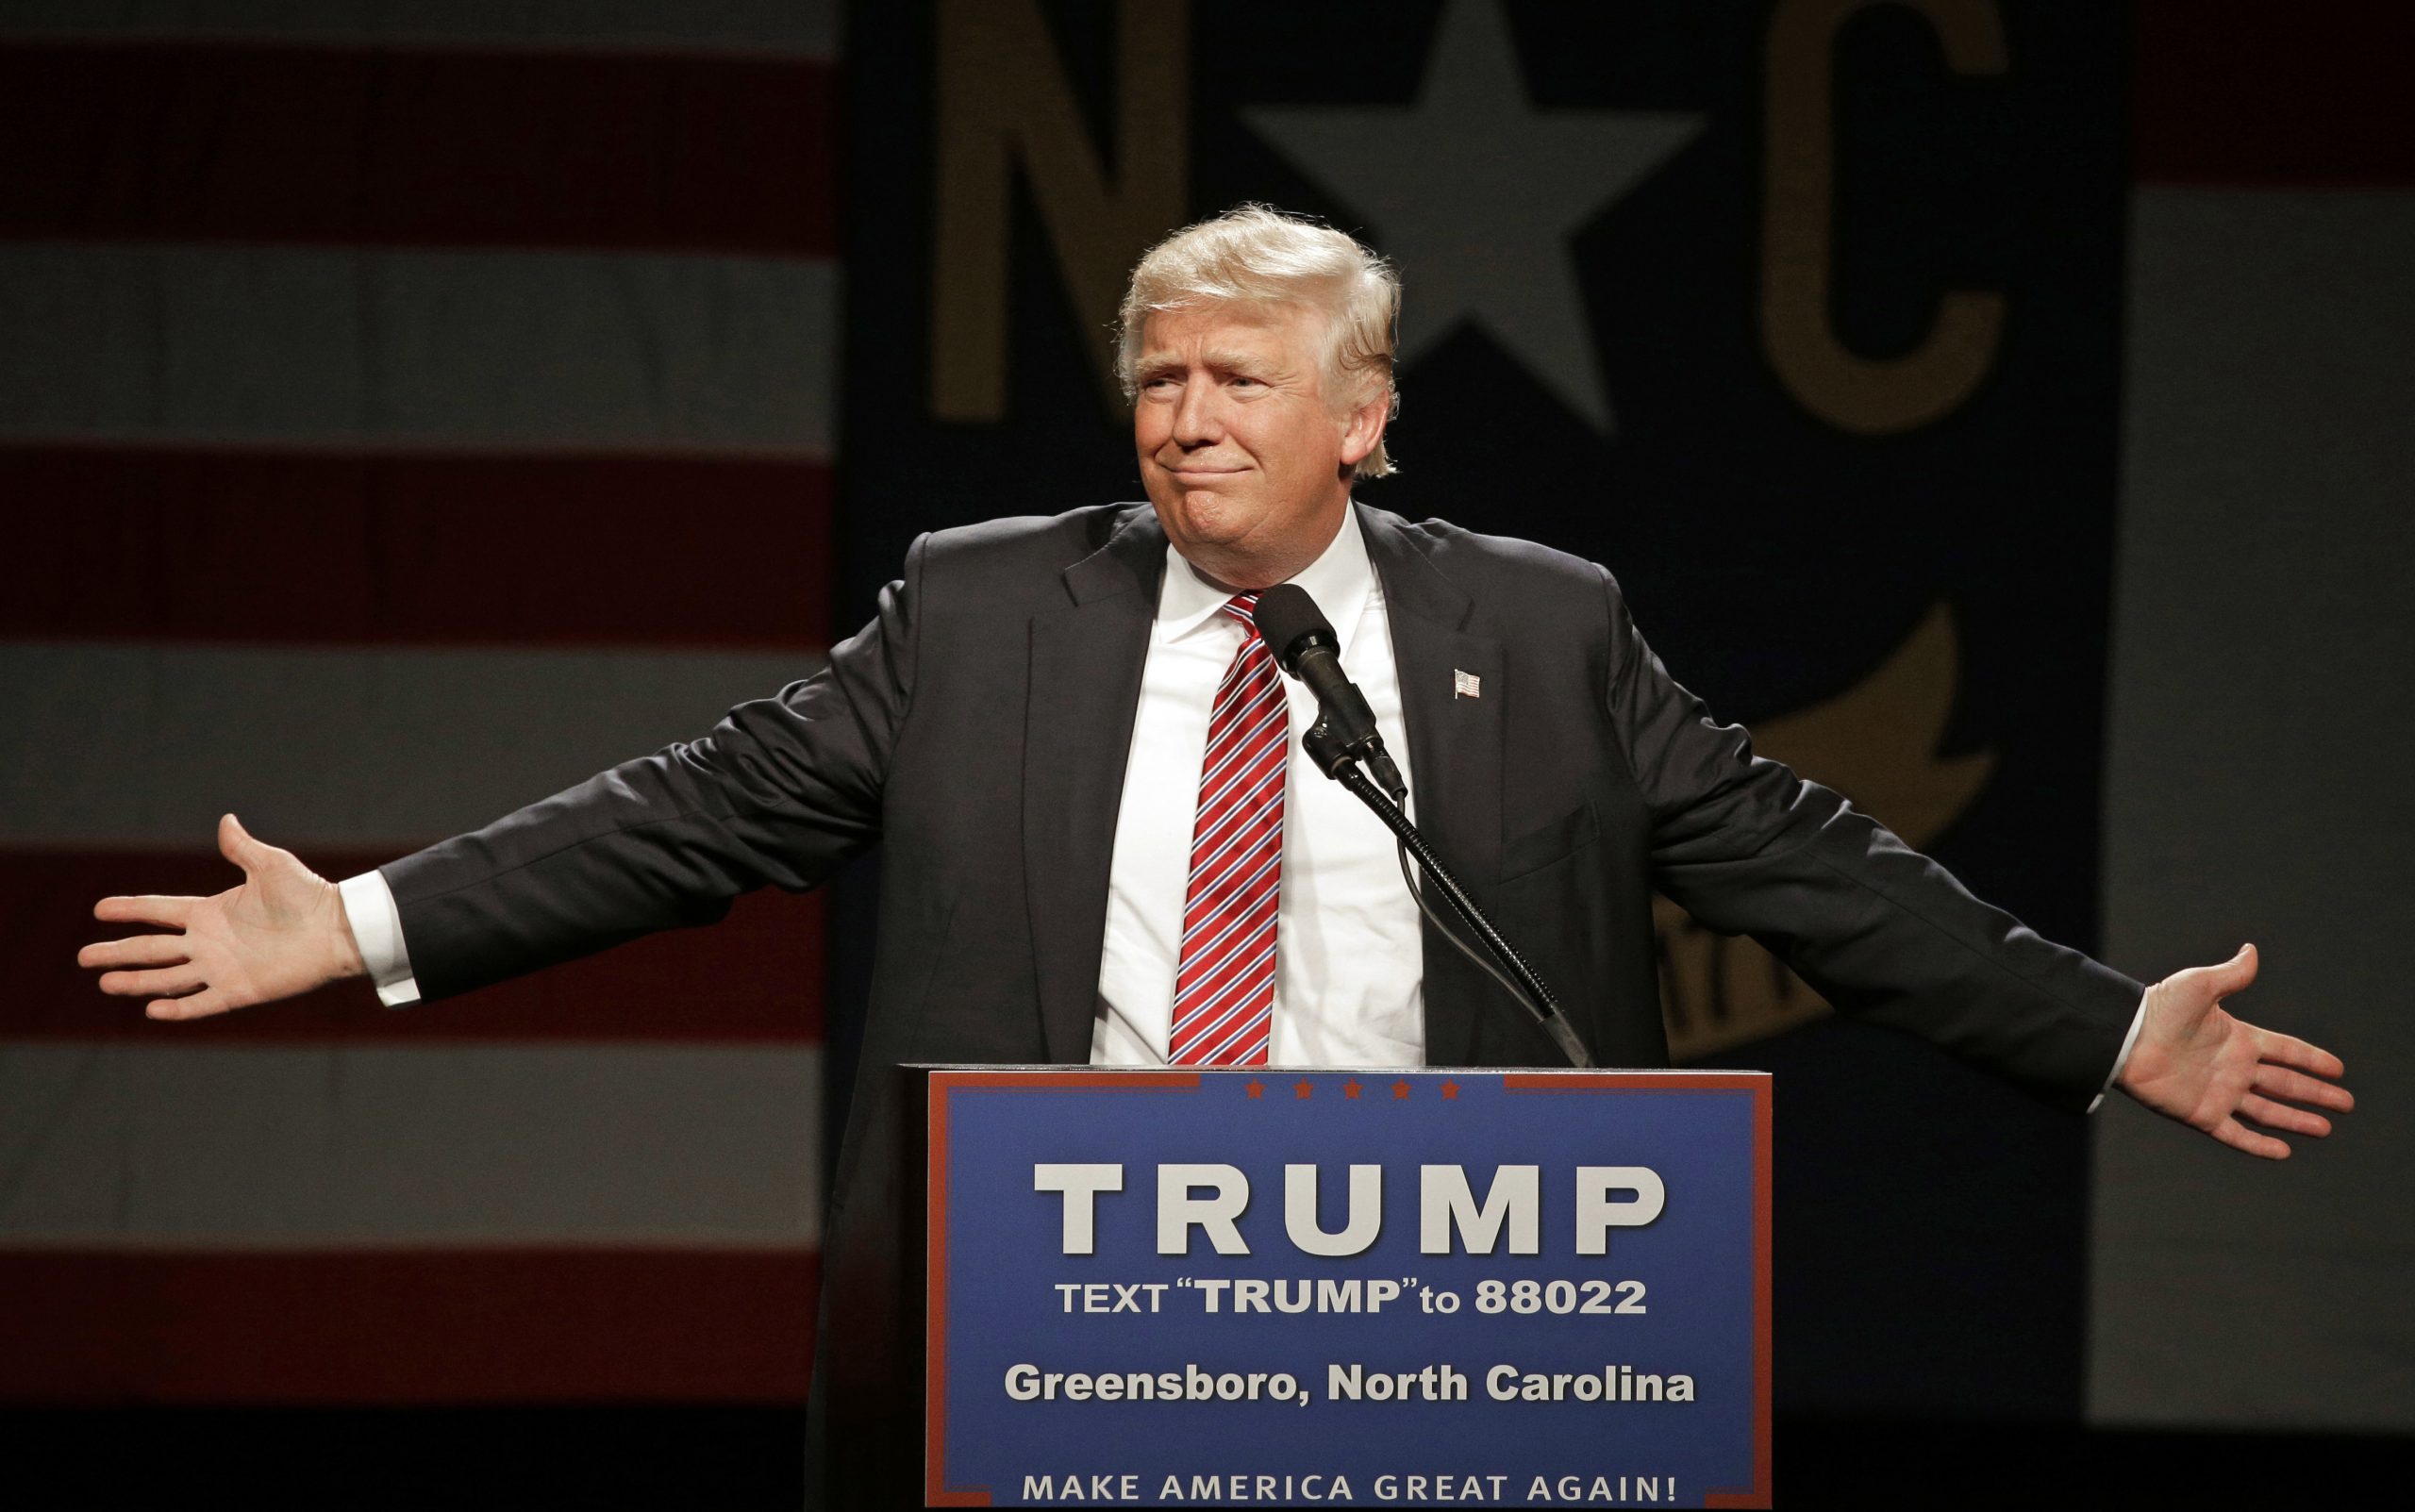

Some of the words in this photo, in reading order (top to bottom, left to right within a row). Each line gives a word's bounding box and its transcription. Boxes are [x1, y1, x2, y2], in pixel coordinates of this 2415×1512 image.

[930, 0, 1191, 424] N
[1760, 0, 2009, 435] C
[1034, 1163, 1667, 1256] TRUMP
[1054, 1284, 1169, 1313] TEXT
[1419, 1285, 1460, 1314] to
[1474, 1279, 1646, 1315] 88022
[1005, 1363, 1309, 1407] Greensboro,
[1328, 1364, 1468, 1401] North
[1486, 1364, 1695, 1402] Carolina
[1023, 1475, 1140, 1501] MAKE
[1158, 1474, 1353, 1501] AMERICA
[1374, 1474, 1507, 1501] GREAT
[1526, 1475, 1676, 1502] AGAIN!
